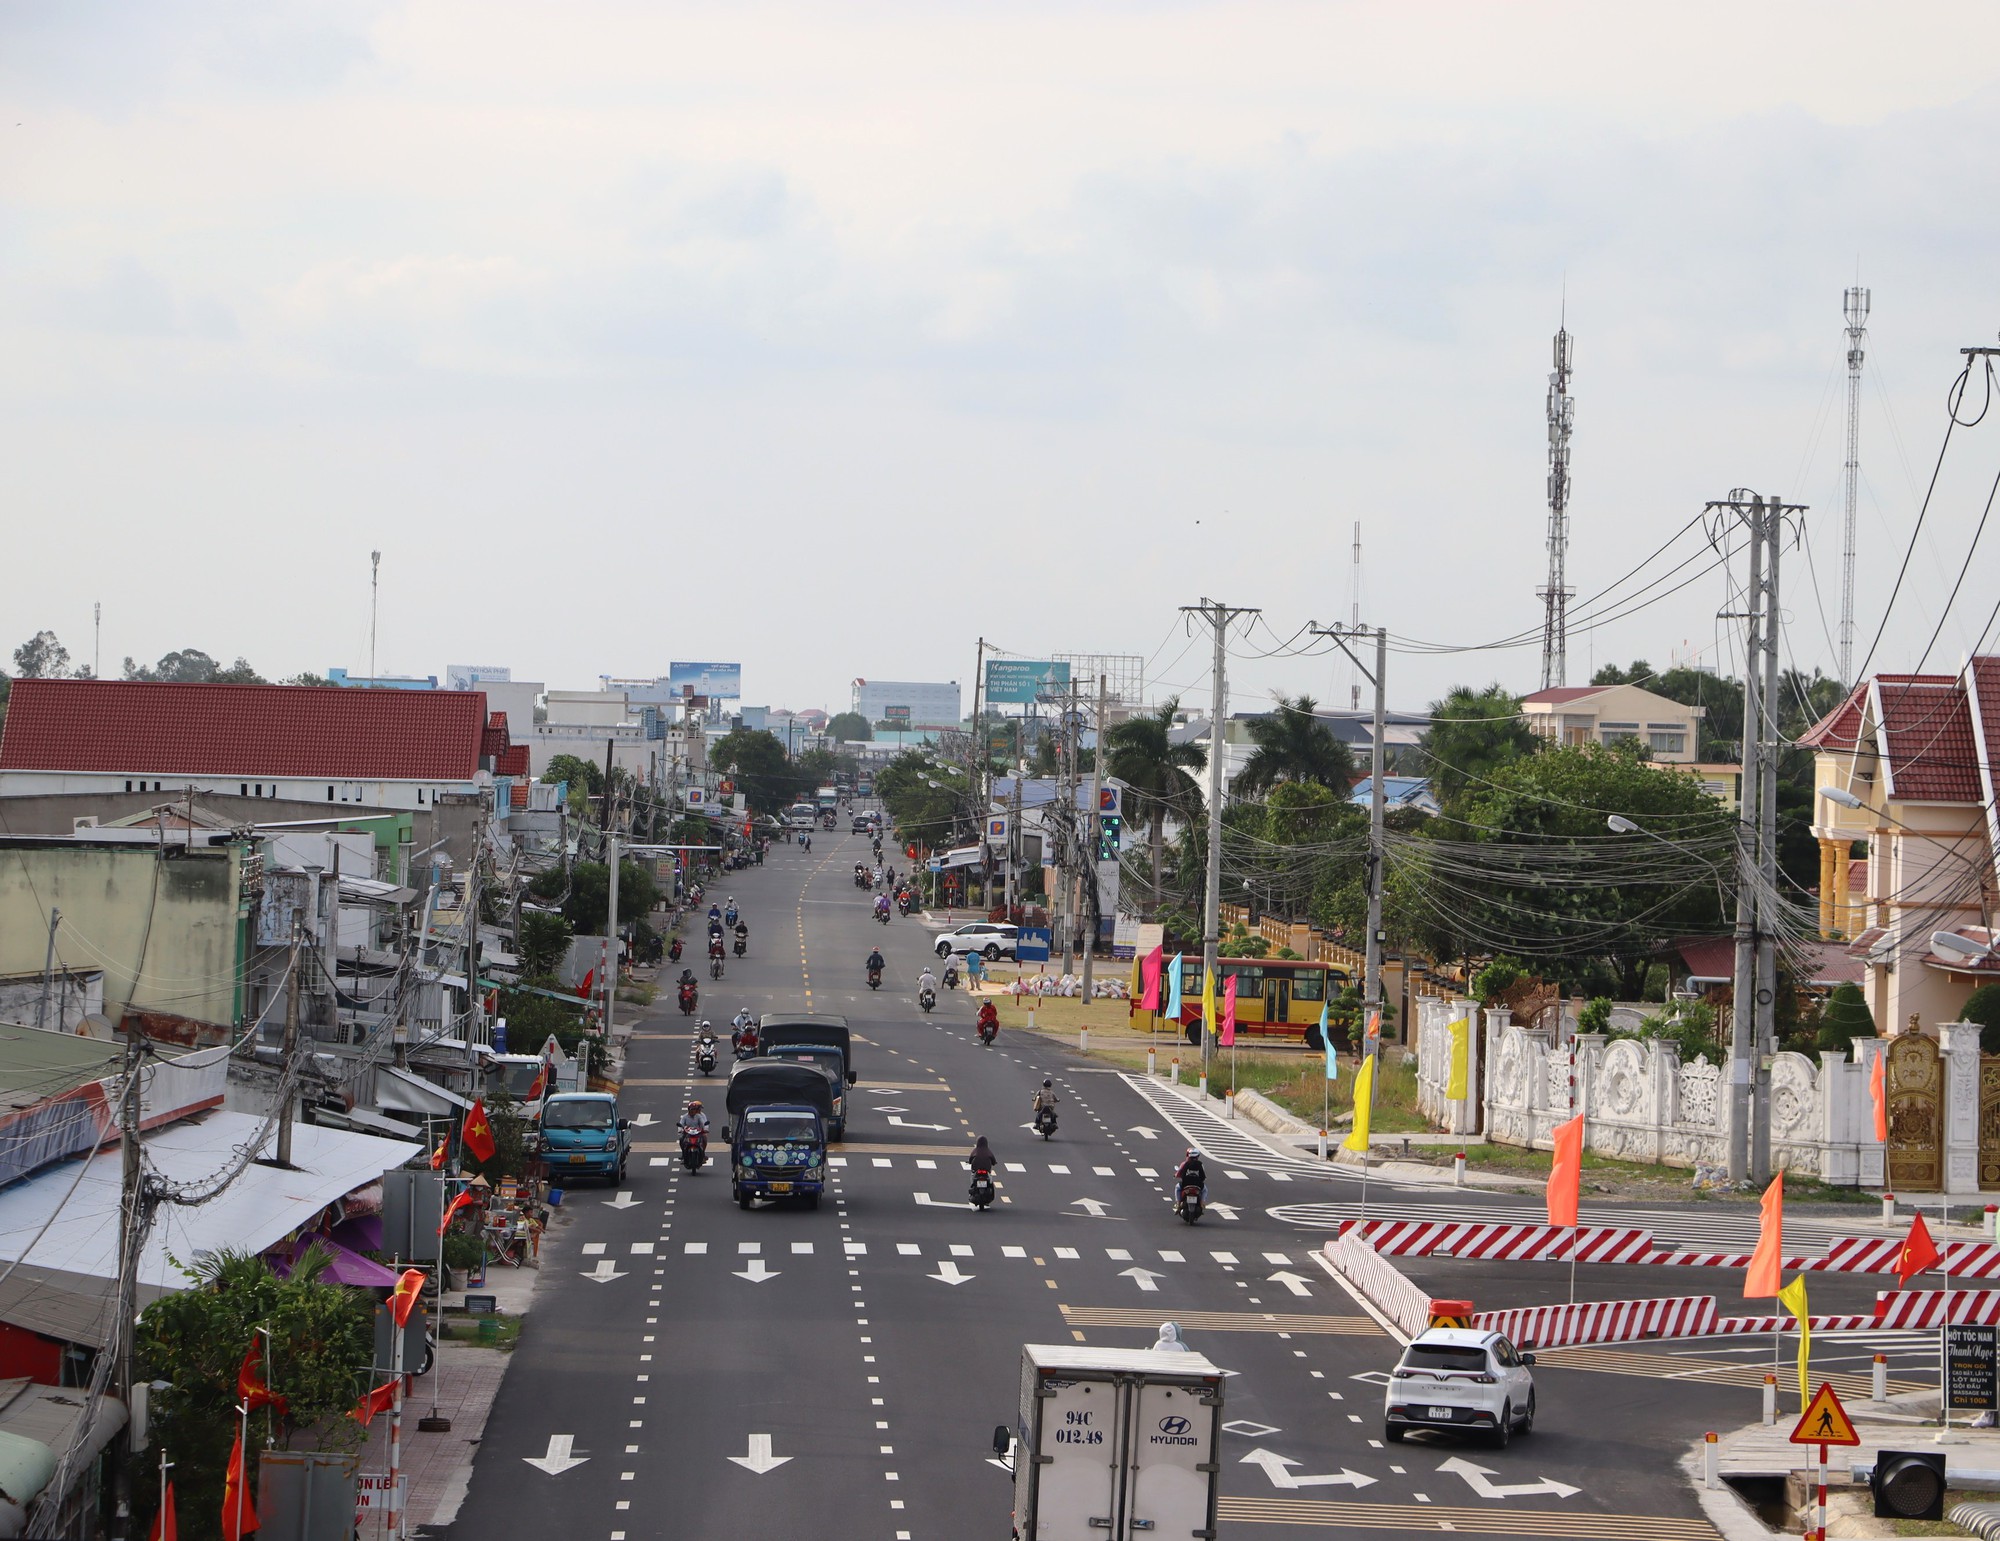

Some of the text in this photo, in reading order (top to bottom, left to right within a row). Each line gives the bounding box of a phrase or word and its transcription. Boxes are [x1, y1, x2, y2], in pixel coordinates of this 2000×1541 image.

[991, 663, 1030, 672] Kangaroo
[1963, 1330, 1976, 1341] TÓC
[1978, 1332, 1993, 1342] NAM
[1948, 1344, 1993, 1360] Thanh Ngọc
[1066, 1411, 1093, 1426] 94C
[1056, 1430, 1103, 1445] 012.48
[1151, 1436, 1197, 1446] HYUNDAI
